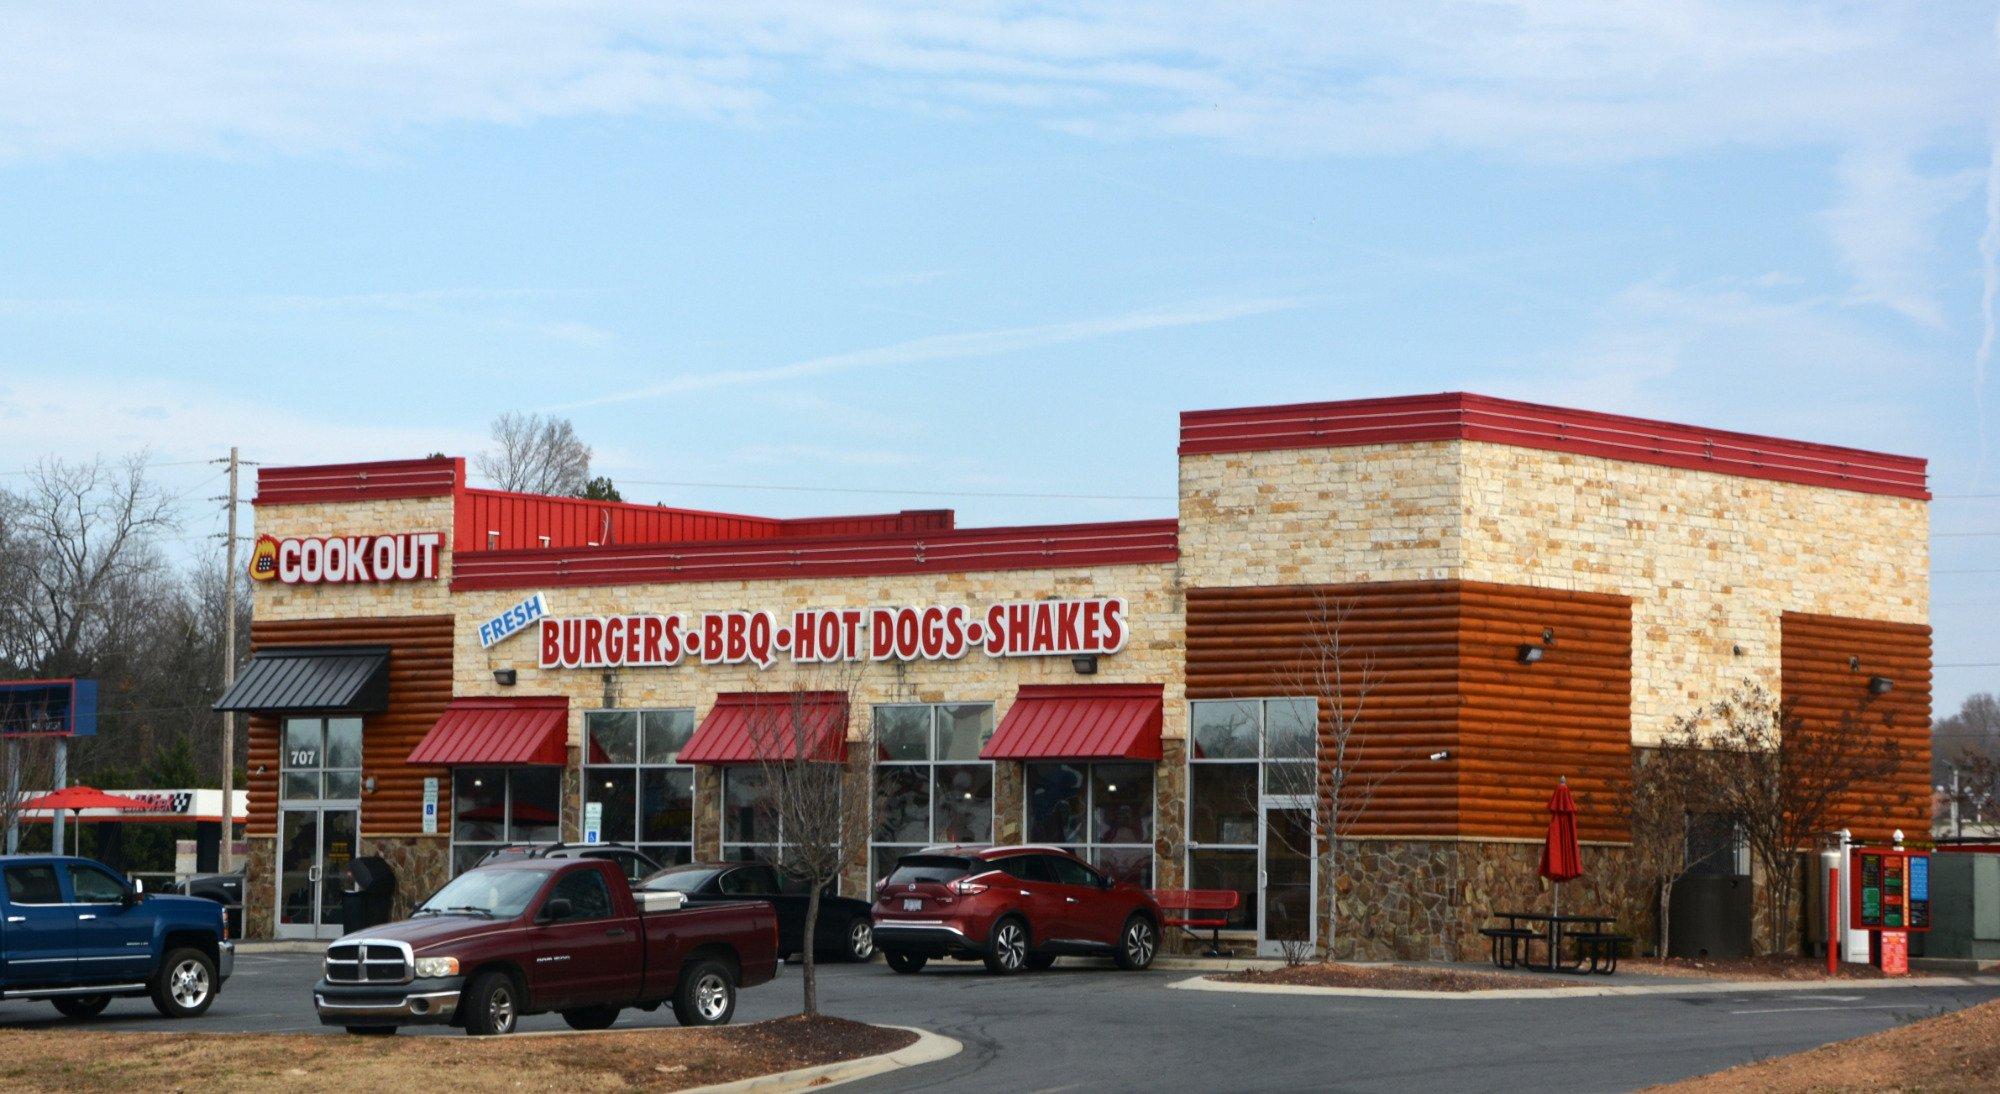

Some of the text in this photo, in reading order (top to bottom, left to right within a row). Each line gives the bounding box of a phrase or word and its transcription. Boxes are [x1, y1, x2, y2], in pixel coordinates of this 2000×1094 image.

[480, 595, 542, 646] FRESH
[542, 600, 1121, 665] BURGERS BBQ HOT DOGS SHAKES
[290, 750, 316, 765] 707
